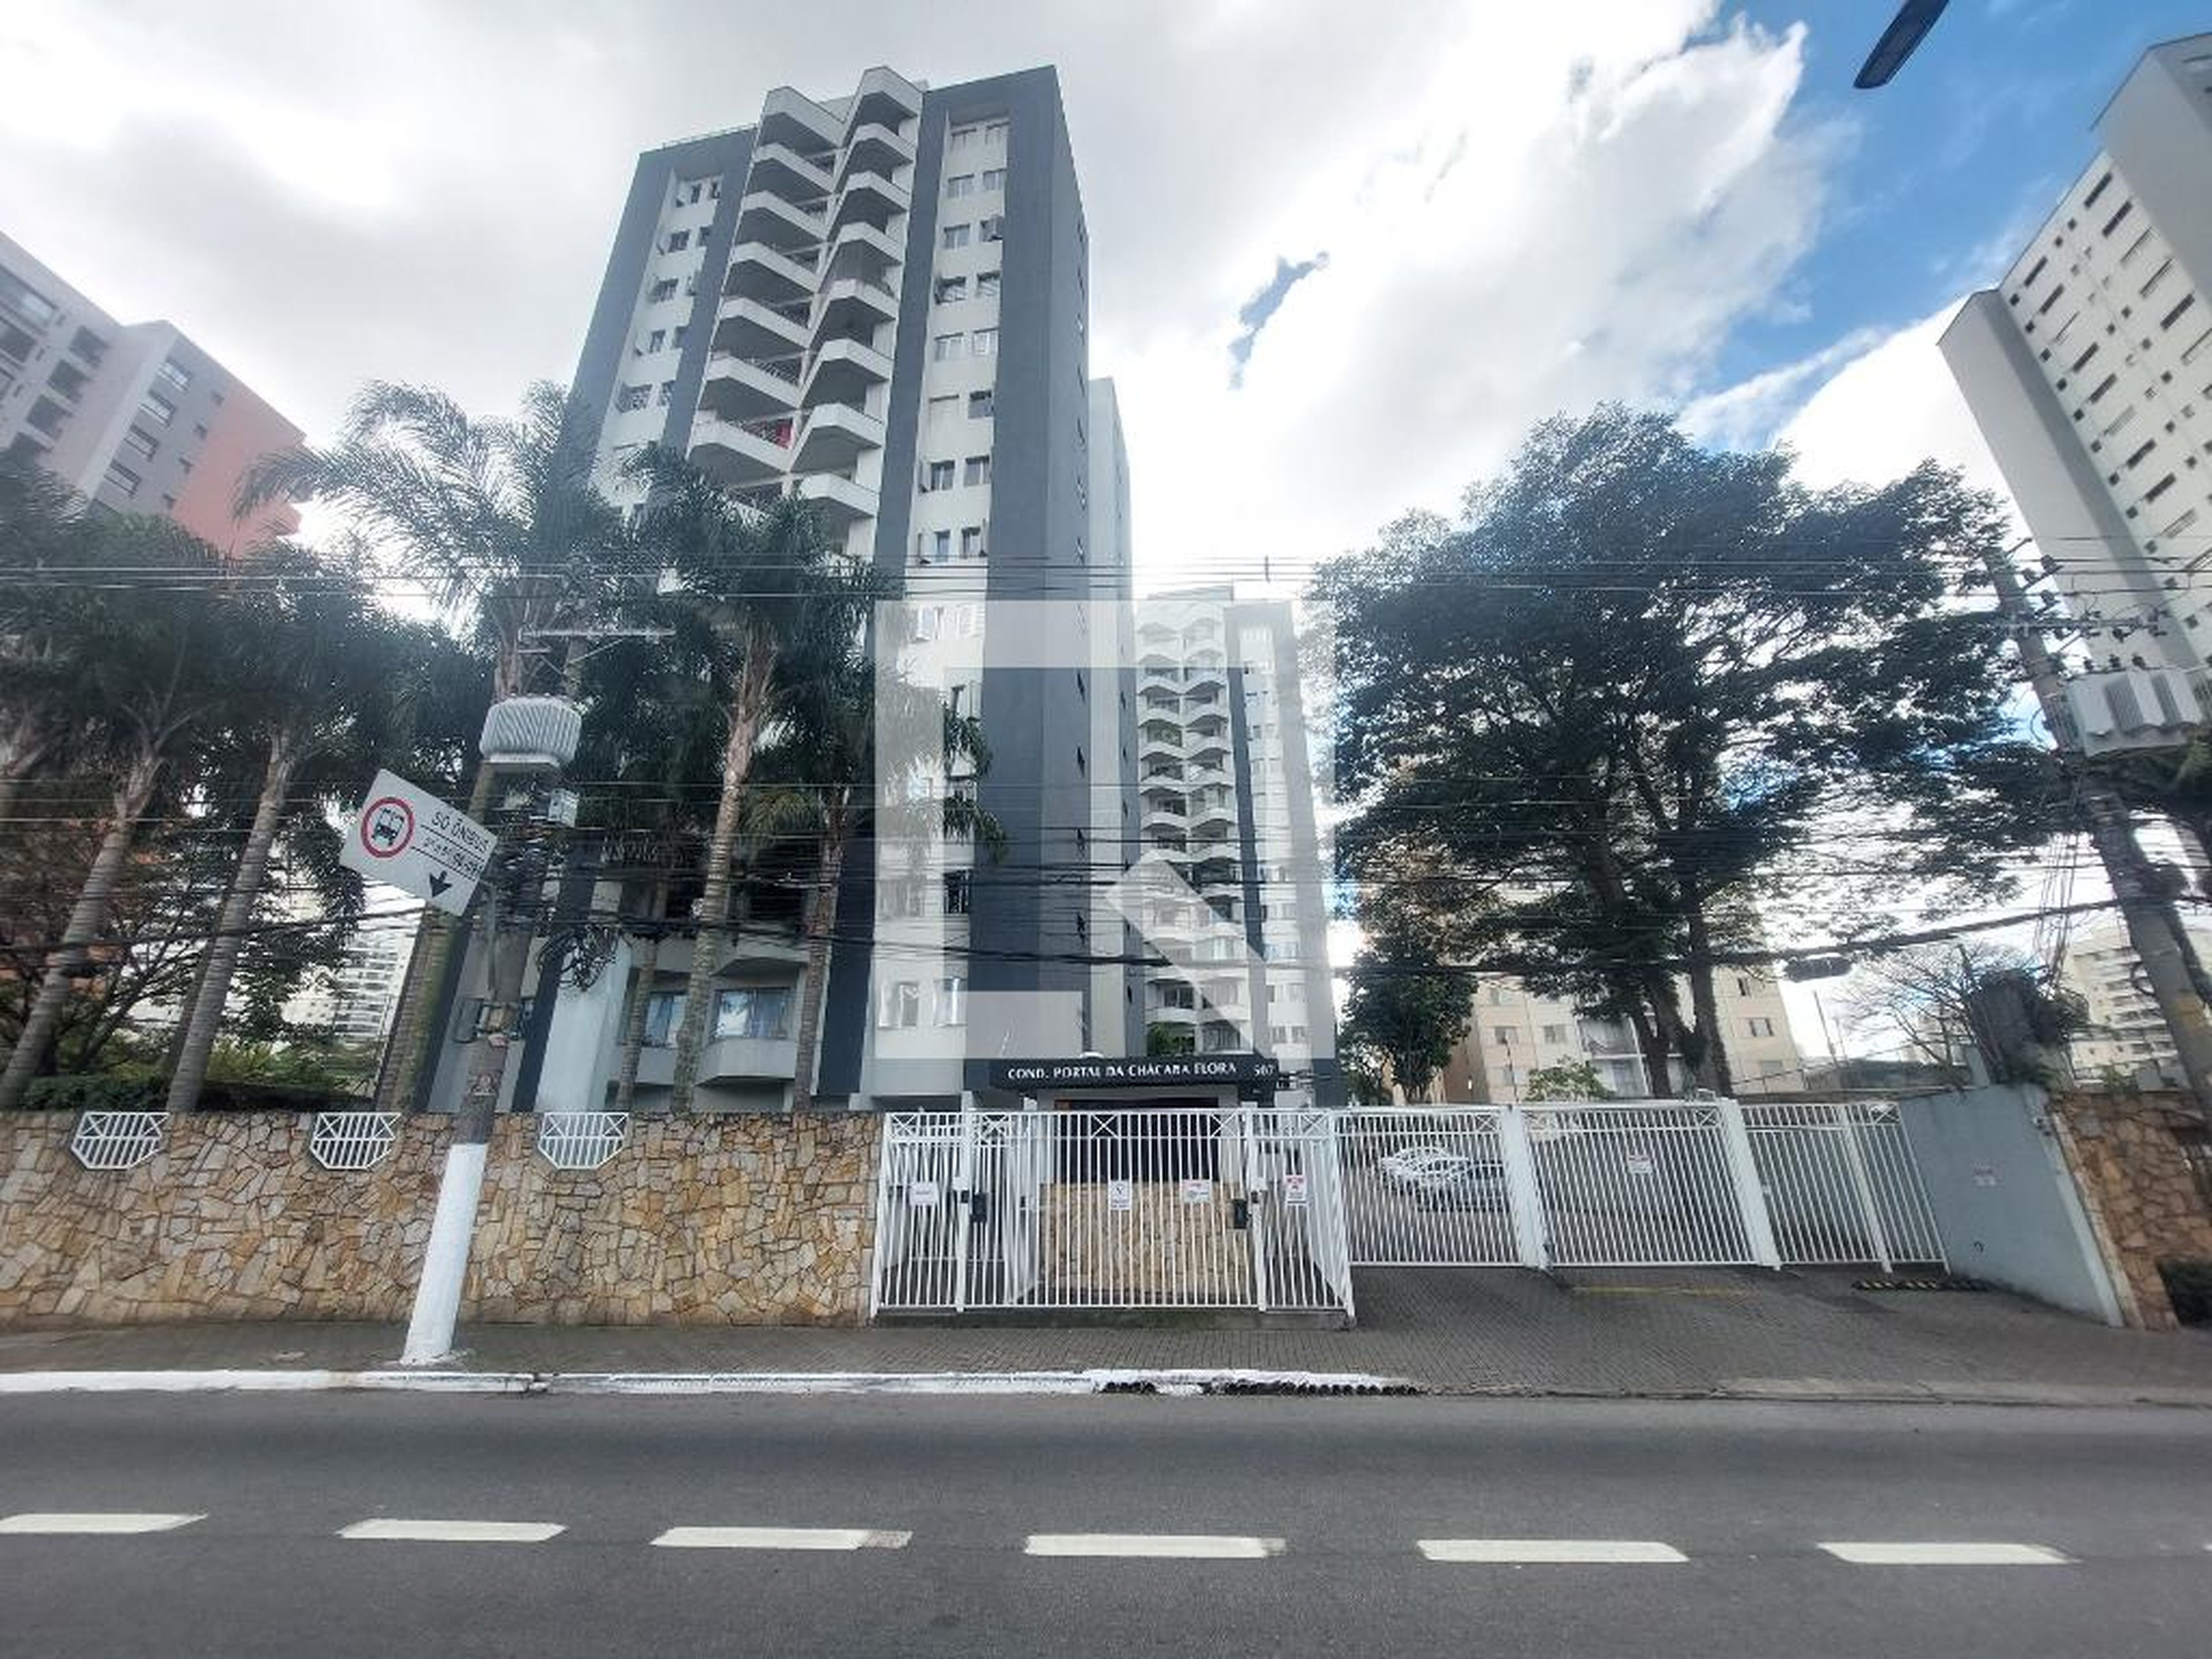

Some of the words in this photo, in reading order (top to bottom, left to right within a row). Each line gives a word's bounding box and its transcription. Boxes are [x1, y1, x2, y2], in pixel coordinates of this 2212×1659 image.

[1008, 1067, 1049, 1080] COND.
[1054, 1066, 1100, 1079] PORTAL
[1105, 1066, 1124, 1078] DA
[1194, 1062, 1236, 1075] FLORA
